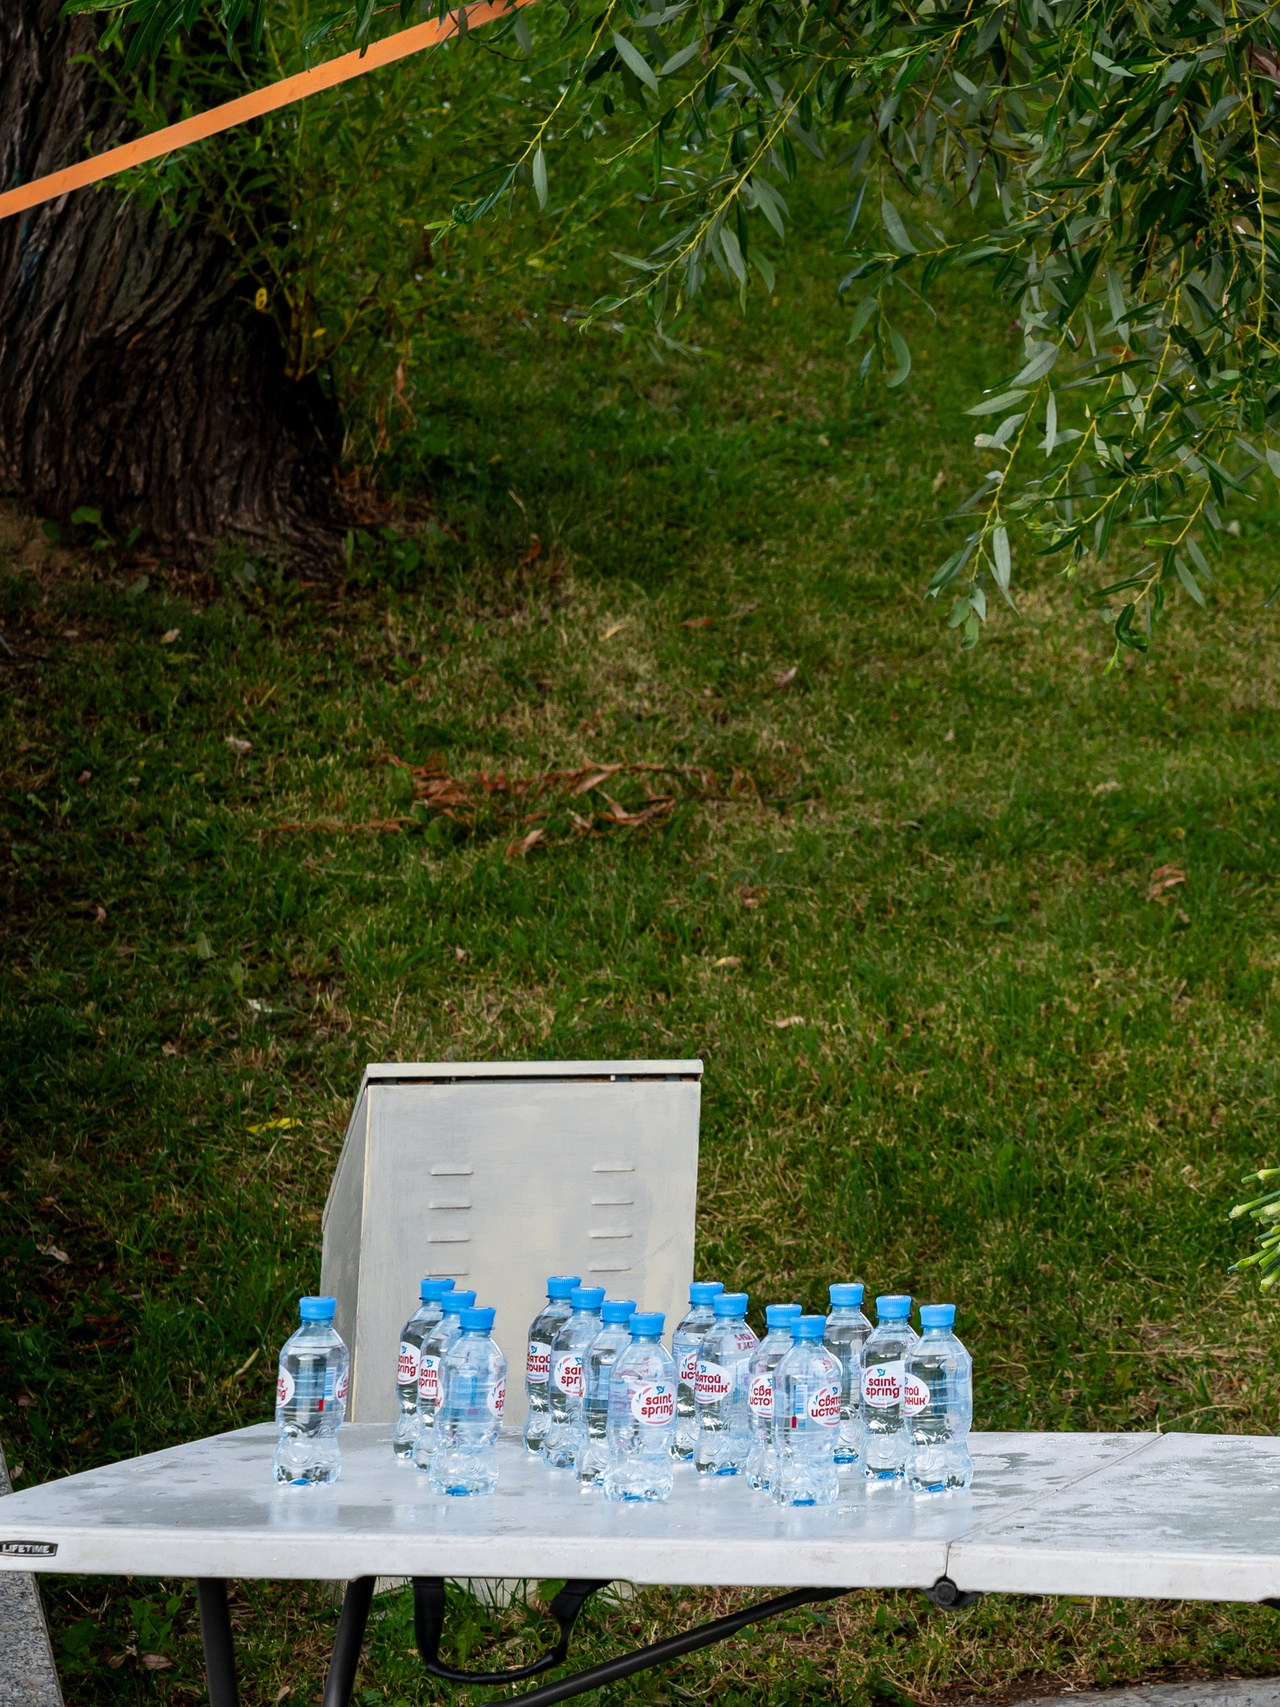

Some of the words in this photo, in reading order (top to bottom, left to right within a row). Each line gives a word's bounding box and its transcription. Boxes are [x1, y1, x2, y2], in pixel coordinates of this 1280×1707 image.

[421, 1368, 437, 1378] sain
[565, 1367, 581, 1375] sai
[868, 1376, 896, 1386] saint
[866, 1387, 900, 1398] spring
[646, 1393, 672, 1405] saint
[641, 1404, 674, 1418] spring
[2, 1544, 50, 1553] LIFETIME
